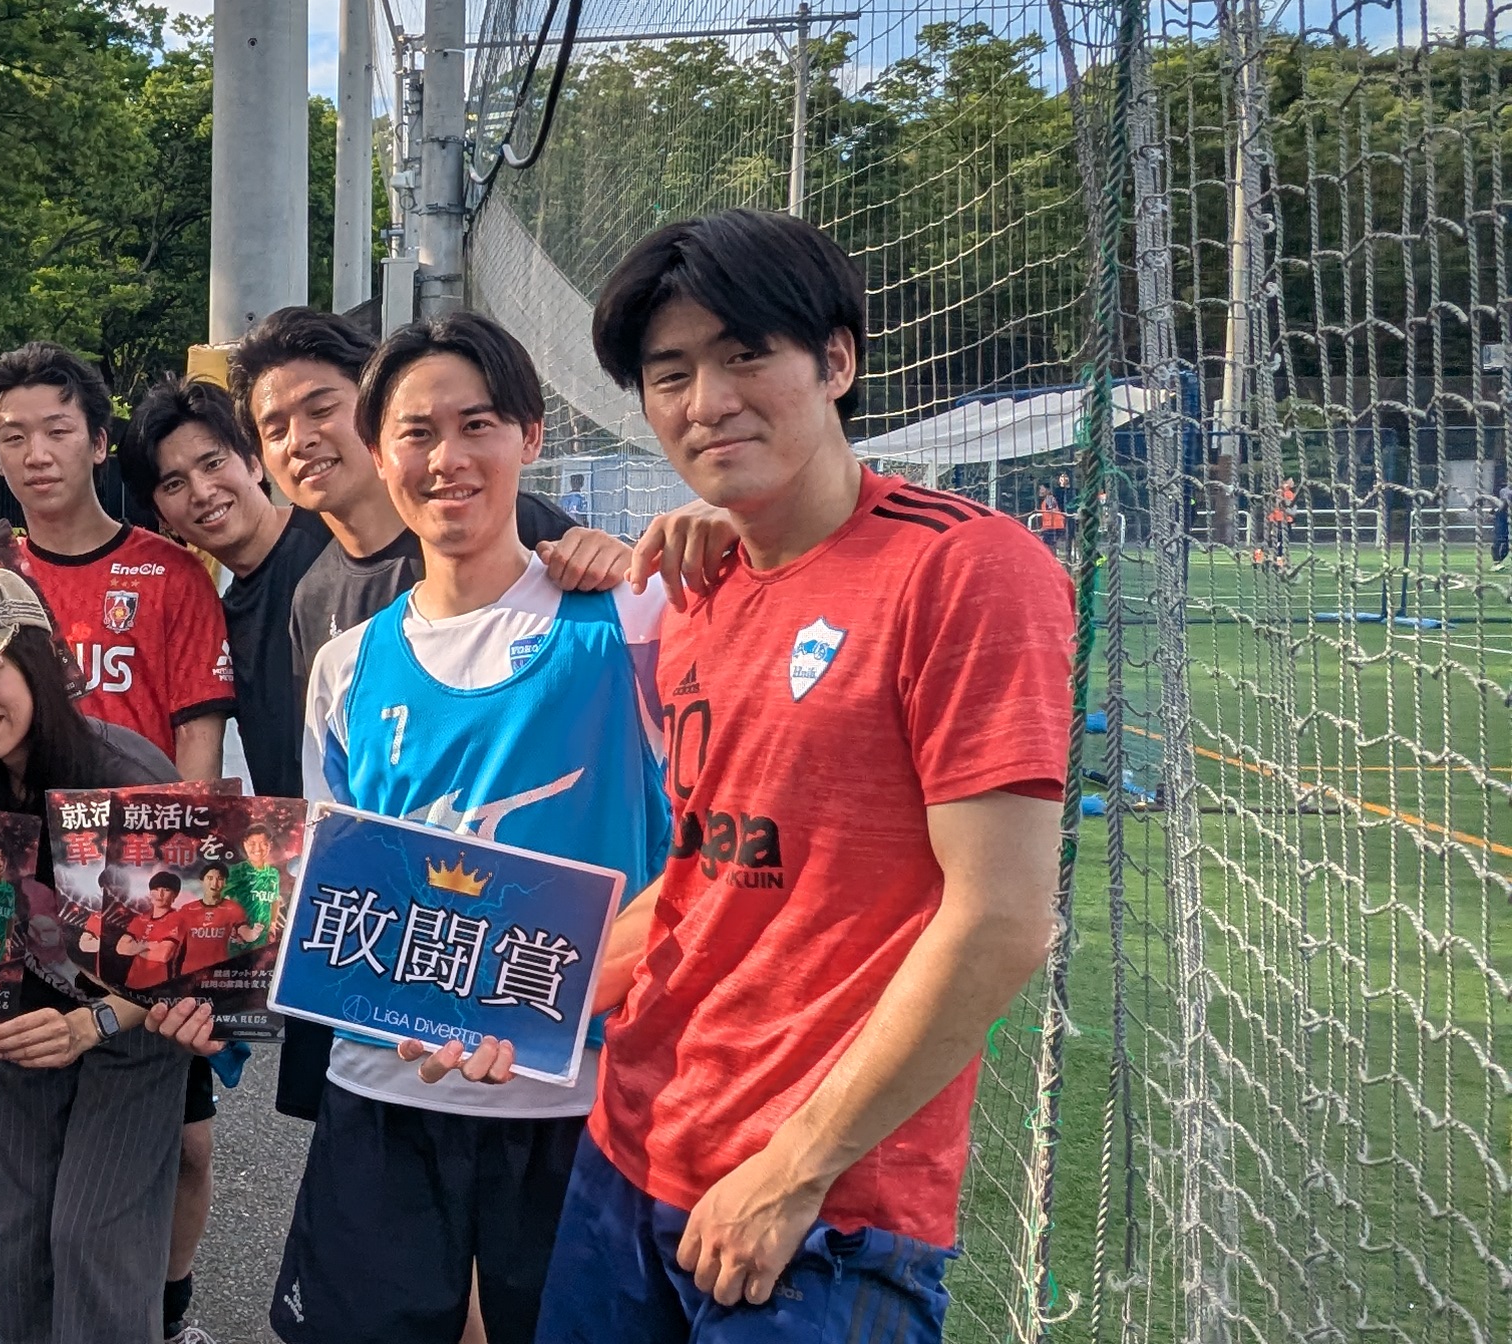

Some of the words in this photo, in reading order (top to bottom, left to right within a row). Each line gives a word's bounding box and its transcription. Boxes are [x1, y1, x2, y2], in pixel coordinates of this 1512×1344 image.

[381, 704, 408, 765] 7
[123, 803, 210, 831] 就活に
[118, 831, 235, 868] 革命を。
[190, 927, 226, 939] POLUS
[303, 884, 580, 1022] 敢闘賞
